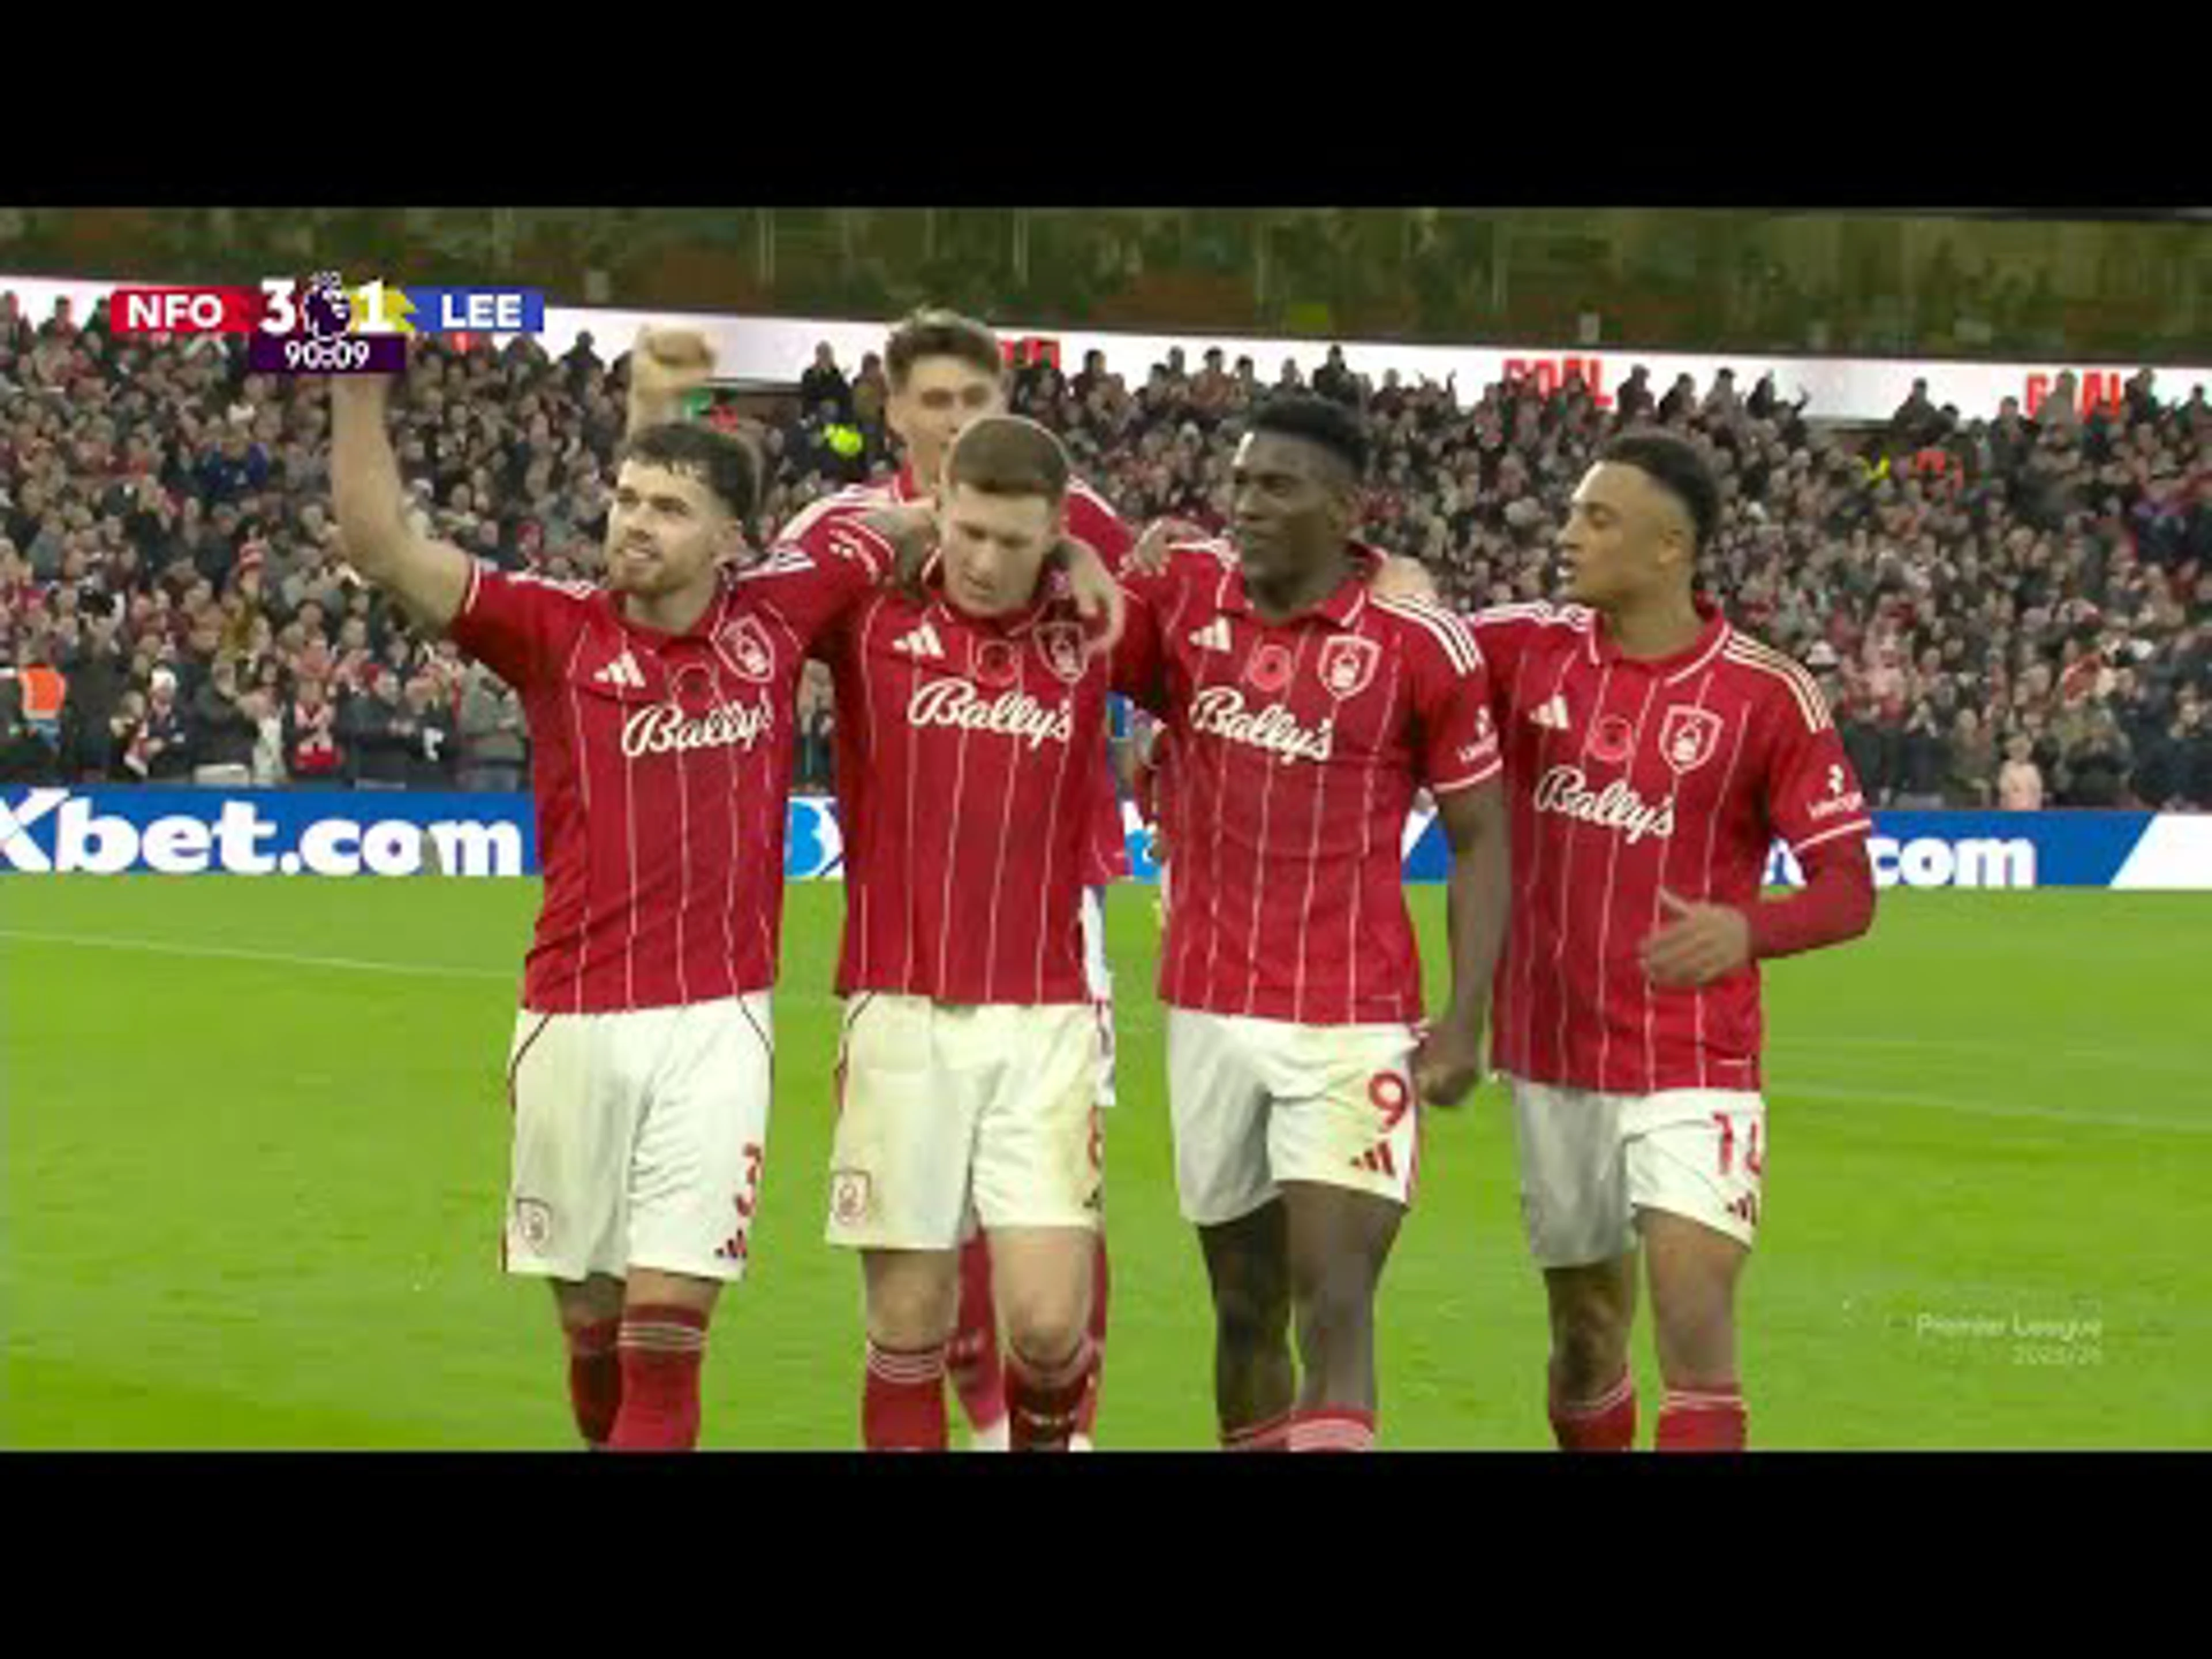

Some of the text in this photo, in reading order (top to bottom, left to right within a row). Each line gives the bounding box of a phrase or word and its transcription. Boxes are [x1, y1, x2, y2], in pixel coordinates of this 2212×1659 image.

[908, 677, 1073, 751] Bally's
[1189, 686, 1334, 765] Bally's
[1535, 765, 1675, 844] Bally's
[1369, 1073, 1407, 1133] 9
